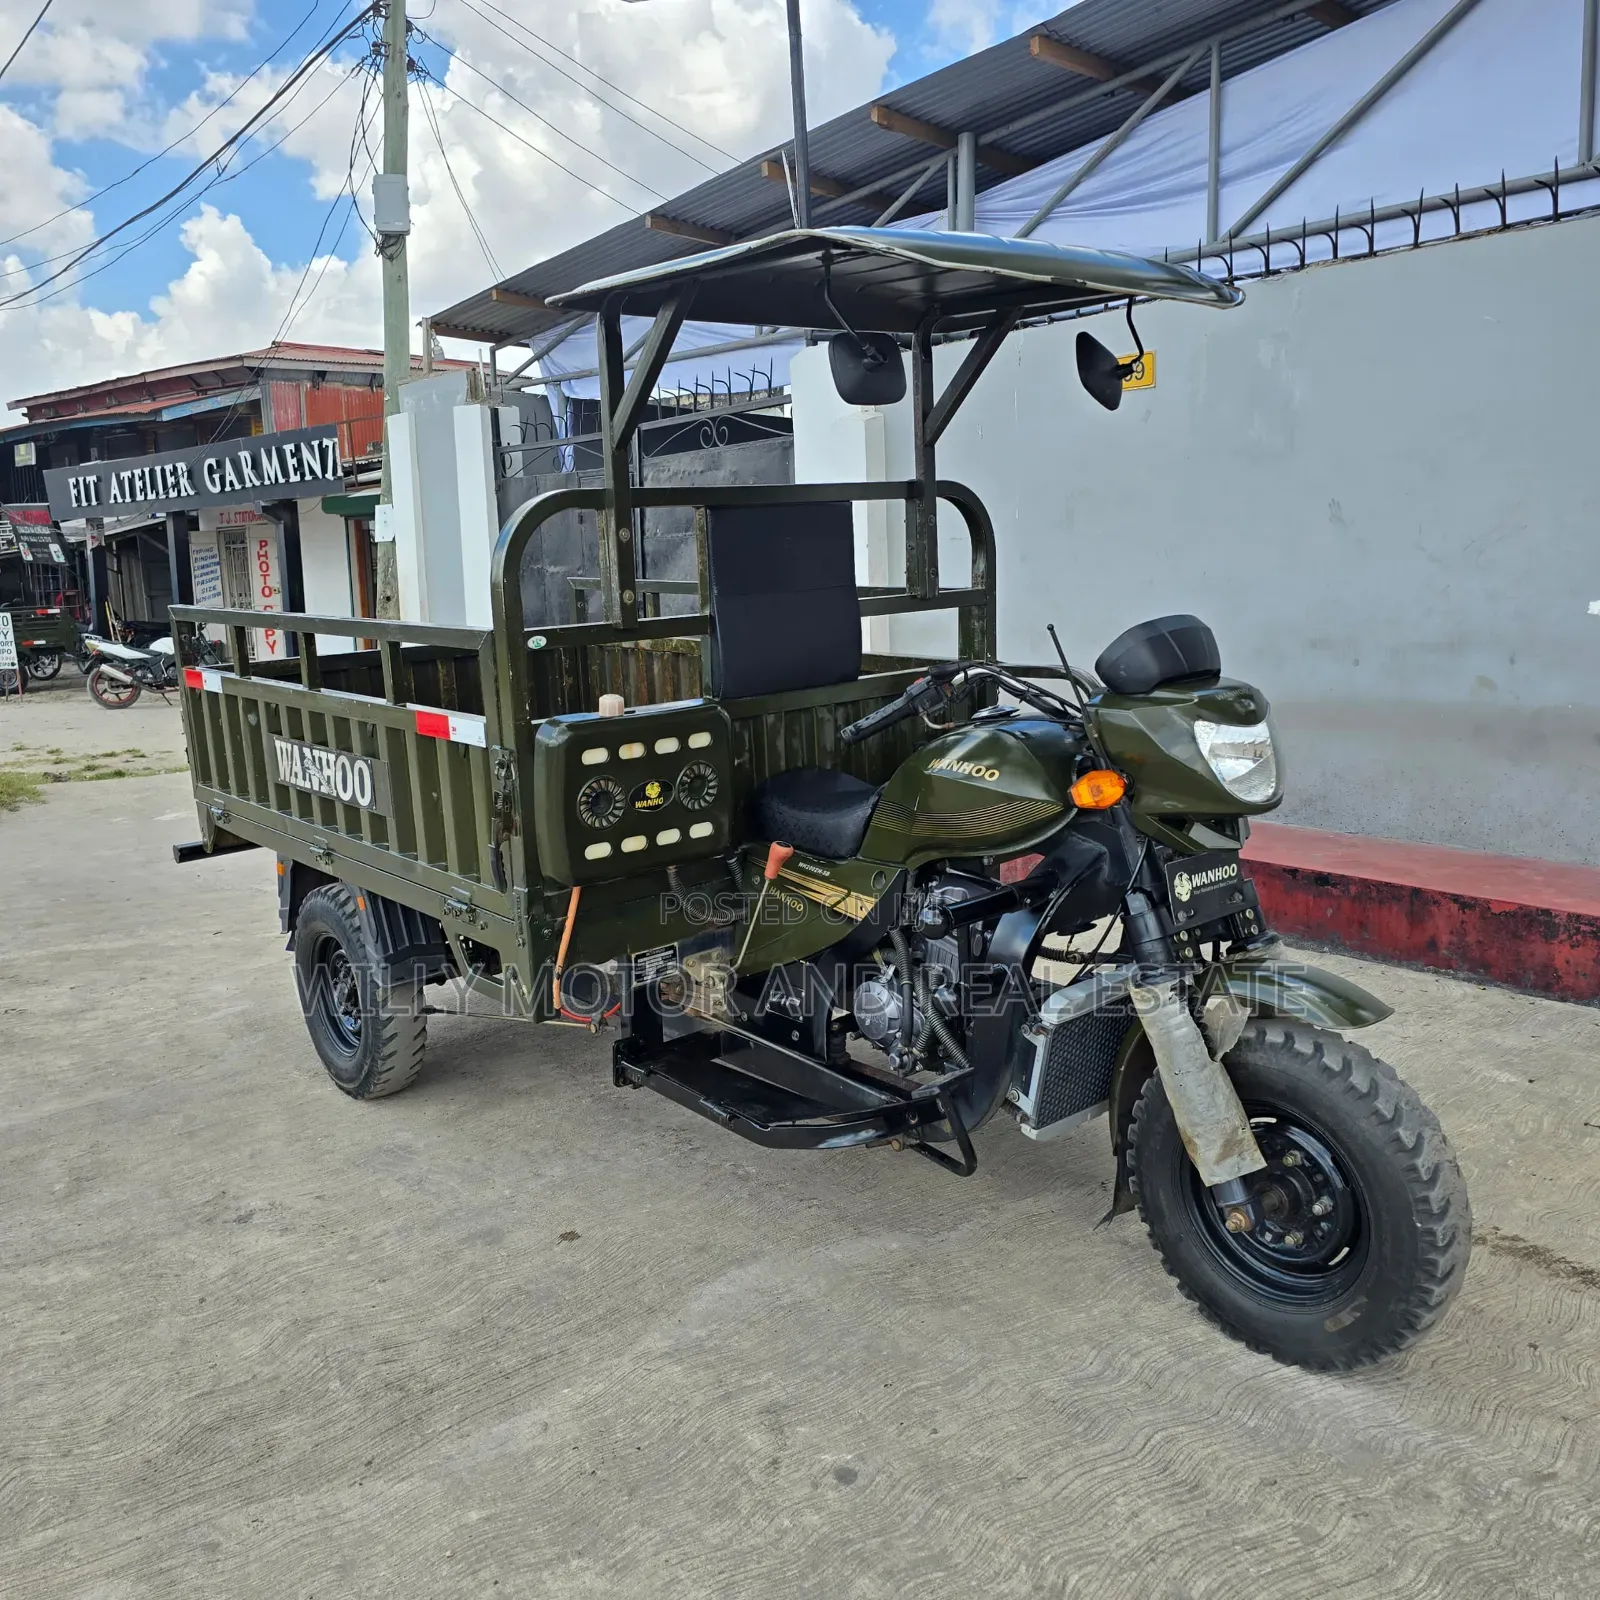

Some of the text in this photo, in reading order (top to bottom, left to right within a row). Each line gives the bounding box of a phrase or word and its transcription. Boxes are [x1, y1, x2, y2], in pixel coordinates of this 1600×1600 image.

[68, 475, 98, 508] FIT
[109, 461, 195, 504] ATELIER
[257, 539, 273, 598] PHOTO
[274, 739, 372, 807] WANHOO
[927, 758, 1000, 782] WANHOO
[1191, 864, 1238, 888] WANHOO
